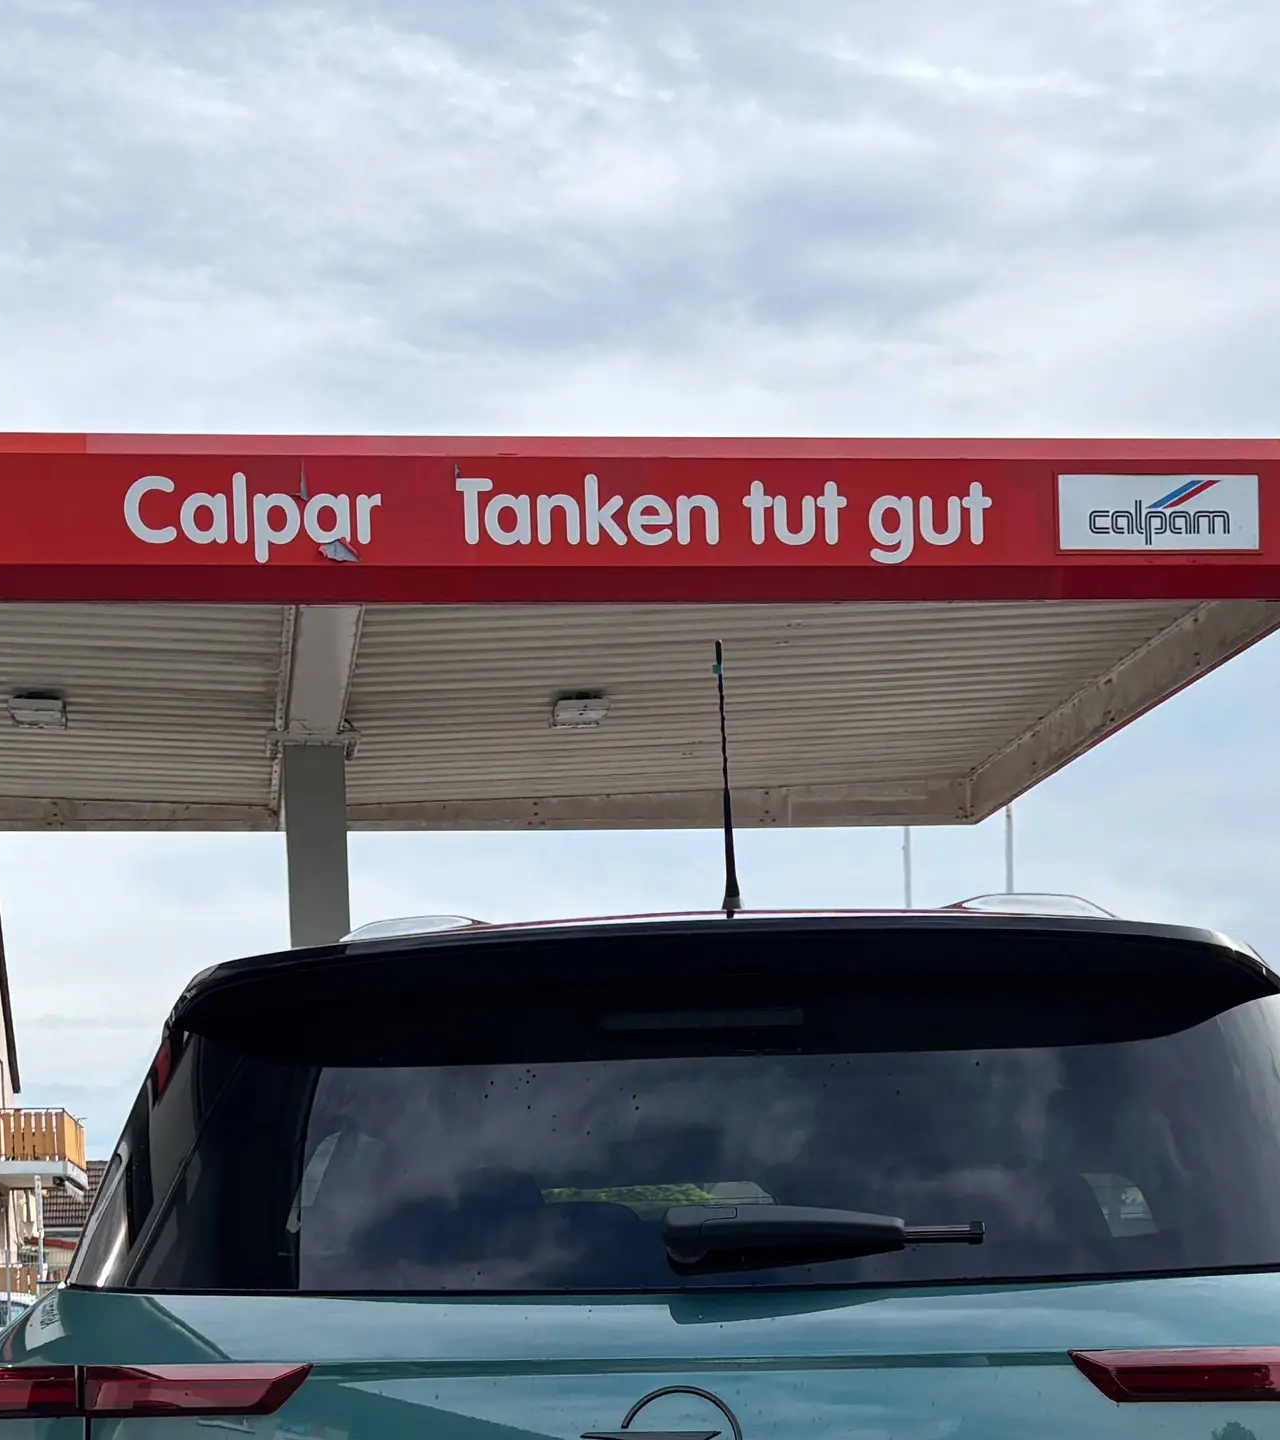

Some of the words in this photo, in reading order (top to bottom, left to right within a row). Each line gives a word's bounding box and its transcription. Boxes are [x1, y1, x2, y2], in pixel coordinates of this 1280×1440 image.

[456, 473, 721, 546] Tanken
[743, 480, 847, 546] tut
[869, 481, 992, 564] gut
[1088, 499, 1230, 546] calpam
